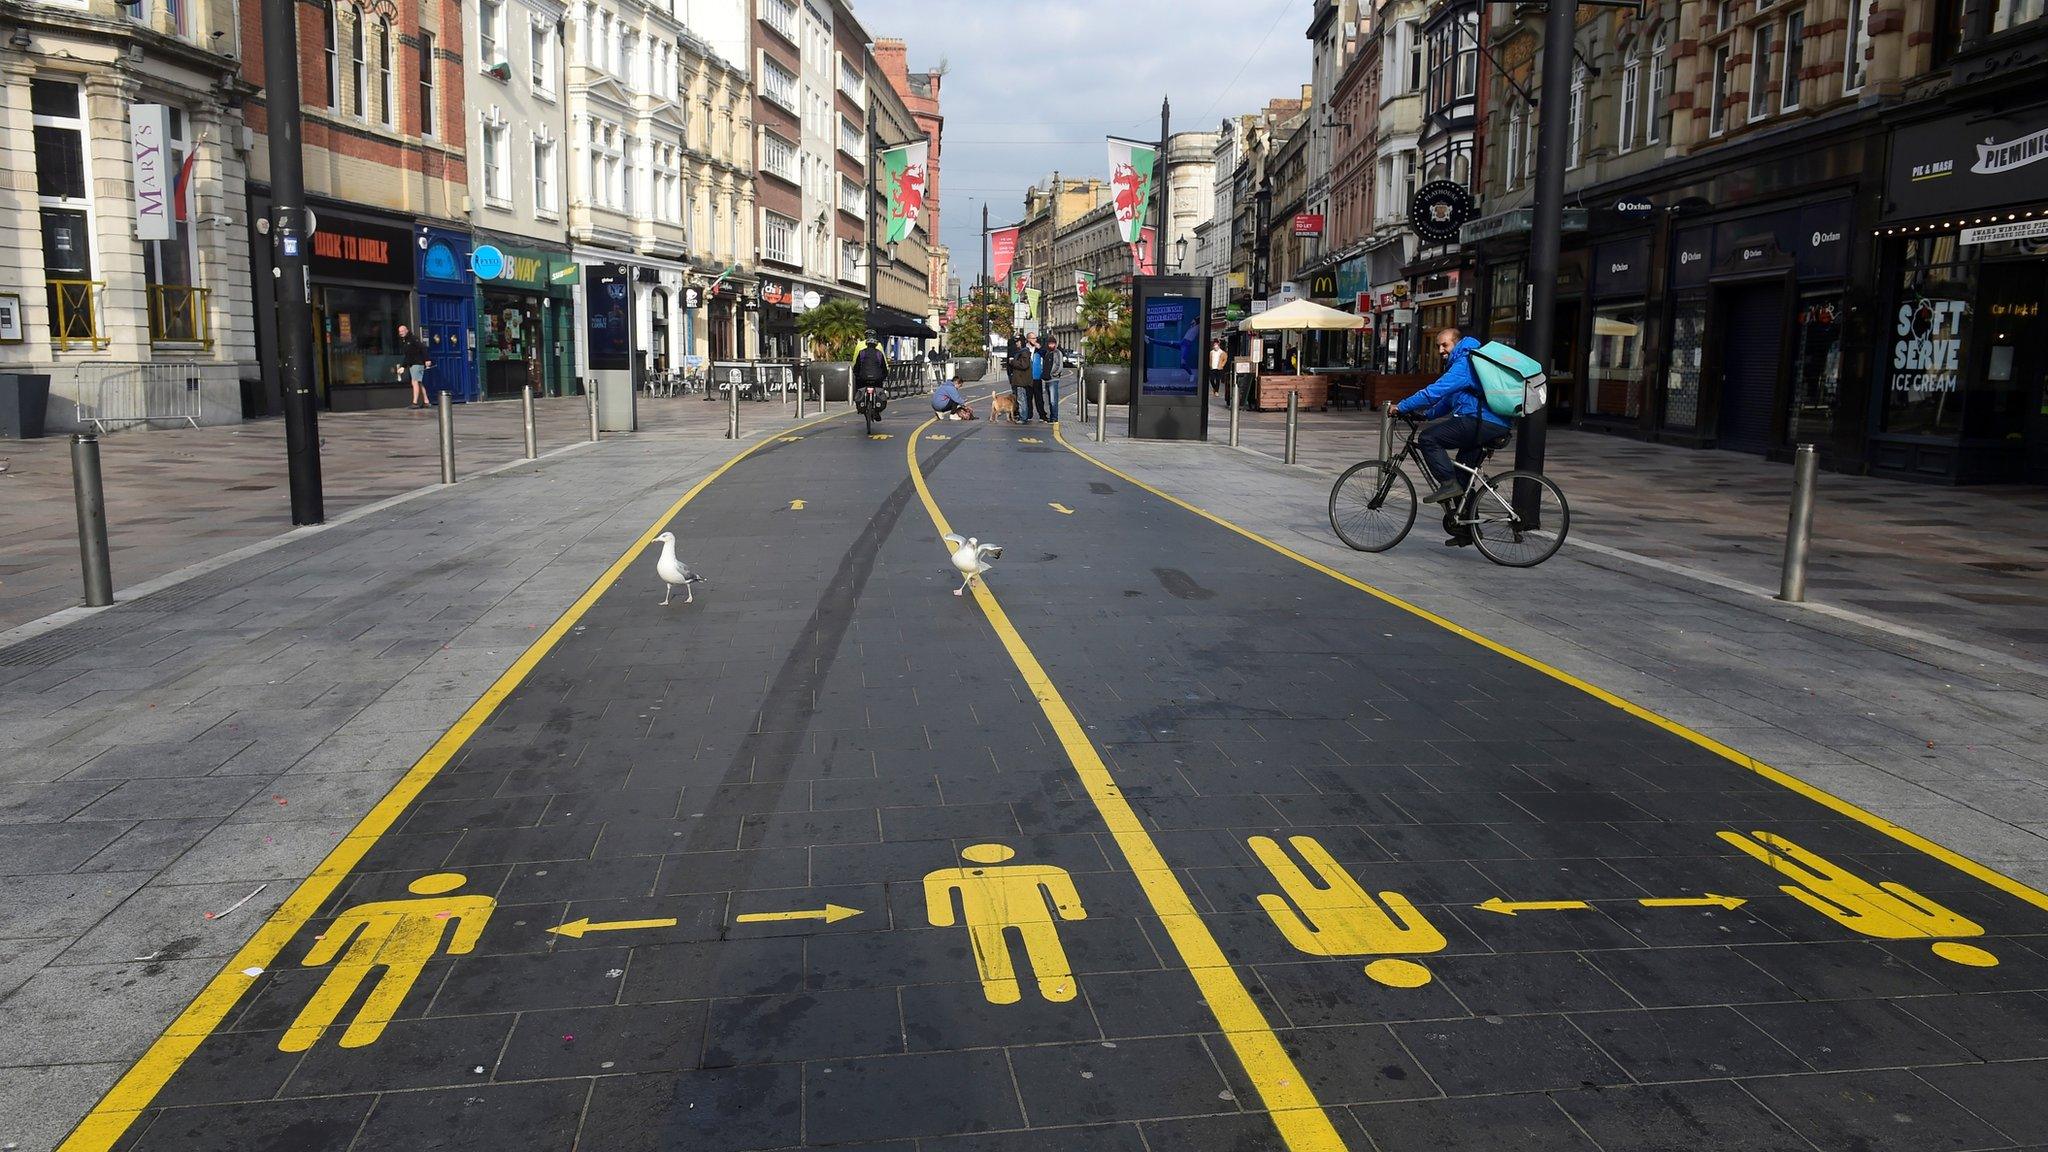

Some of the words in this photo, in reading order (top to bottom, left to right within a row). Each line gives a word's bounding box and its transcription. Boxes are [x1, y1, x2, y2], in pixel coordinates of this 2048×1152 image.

[1912, 166, 1924, 177] PIE
[1932, 159, 1953, 173] MASH
[1424, 189, 1459, 202] PLAYHOUSE
[1627, 203, 1651, 211] Oxfam
[1973, 228, 1997, 236] AWARD
[1999, 223, 2032, 233] WINNING
[2014, 230, 2026, 238] ICE
[1822, 232, 1840, 243] Oxfam
[343, 235, 357, 259] TO
[358, 237, 388, 264] WALK
[551, 265, 577, 281] SUBWAY
[1893, 339, 1961, 370] SERVE
[1891, 373, 1912, 391] ICE
[1913, 374, 1957, 392] CREAM
